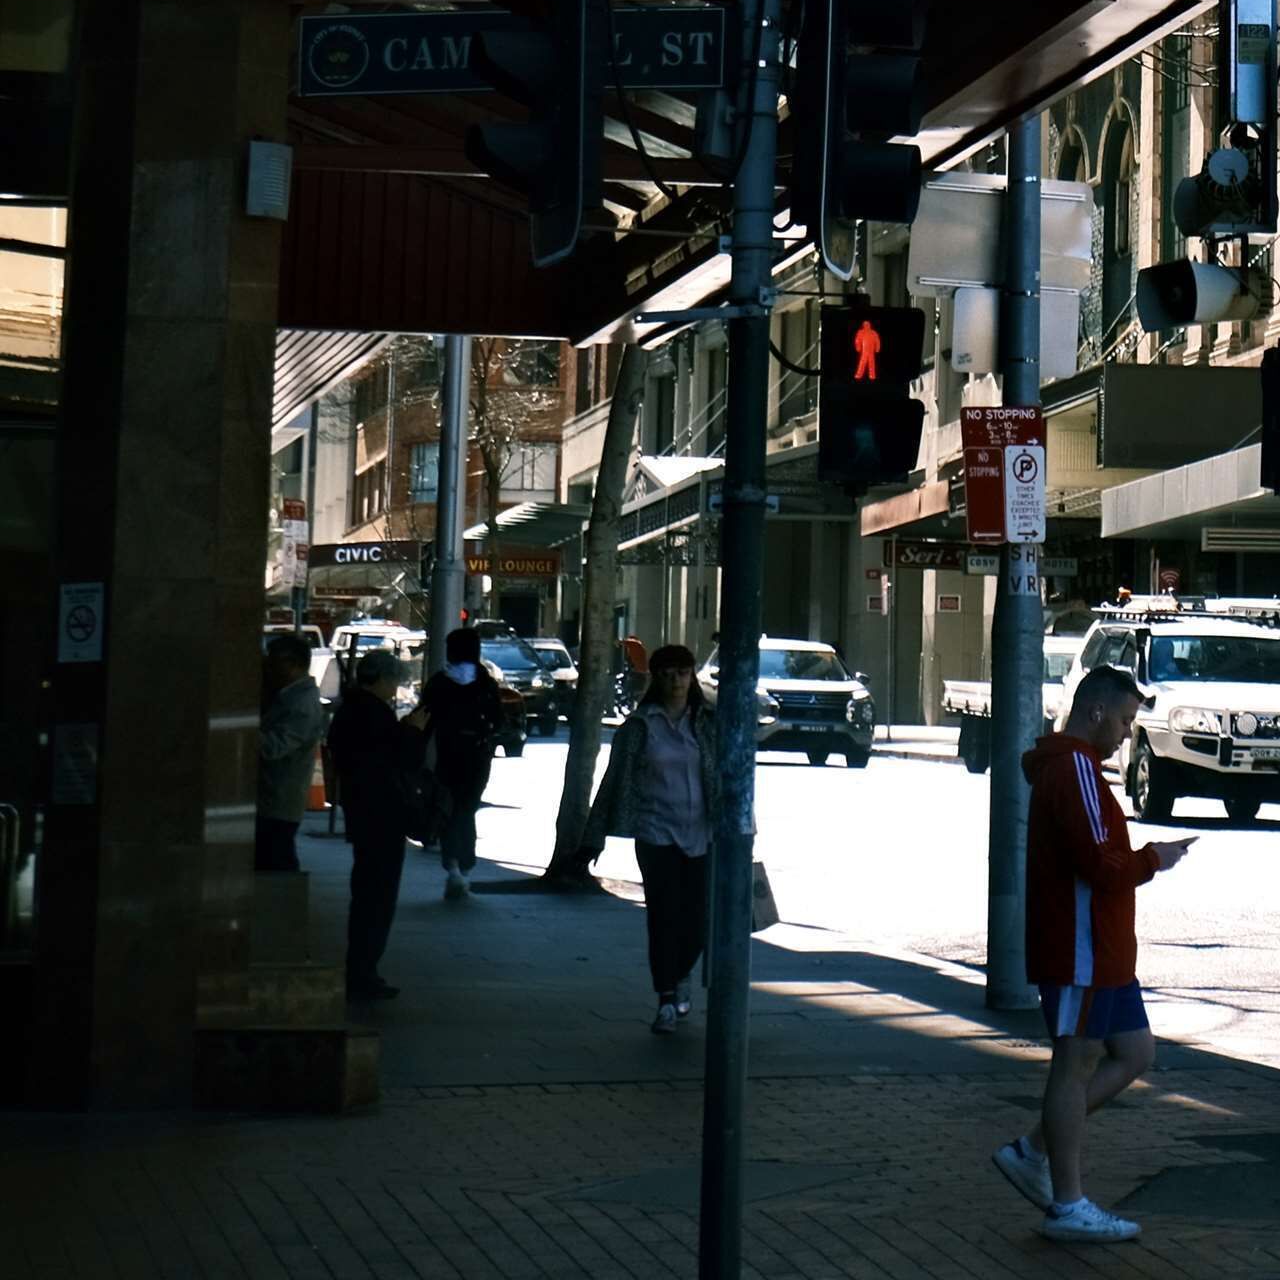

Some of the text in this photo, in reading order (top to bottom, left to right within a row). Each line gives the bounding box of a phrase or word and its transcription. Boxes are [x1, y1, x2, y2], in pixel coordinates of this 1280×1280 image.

[661, 31, 714, 67] ST
[966, 409, 1036, 420] NO STOPPING
[977, 452, 989, 463] NO
[335, 546, 382, 564] CIVIC
[498, 560, 554, 574] LOUNGE
